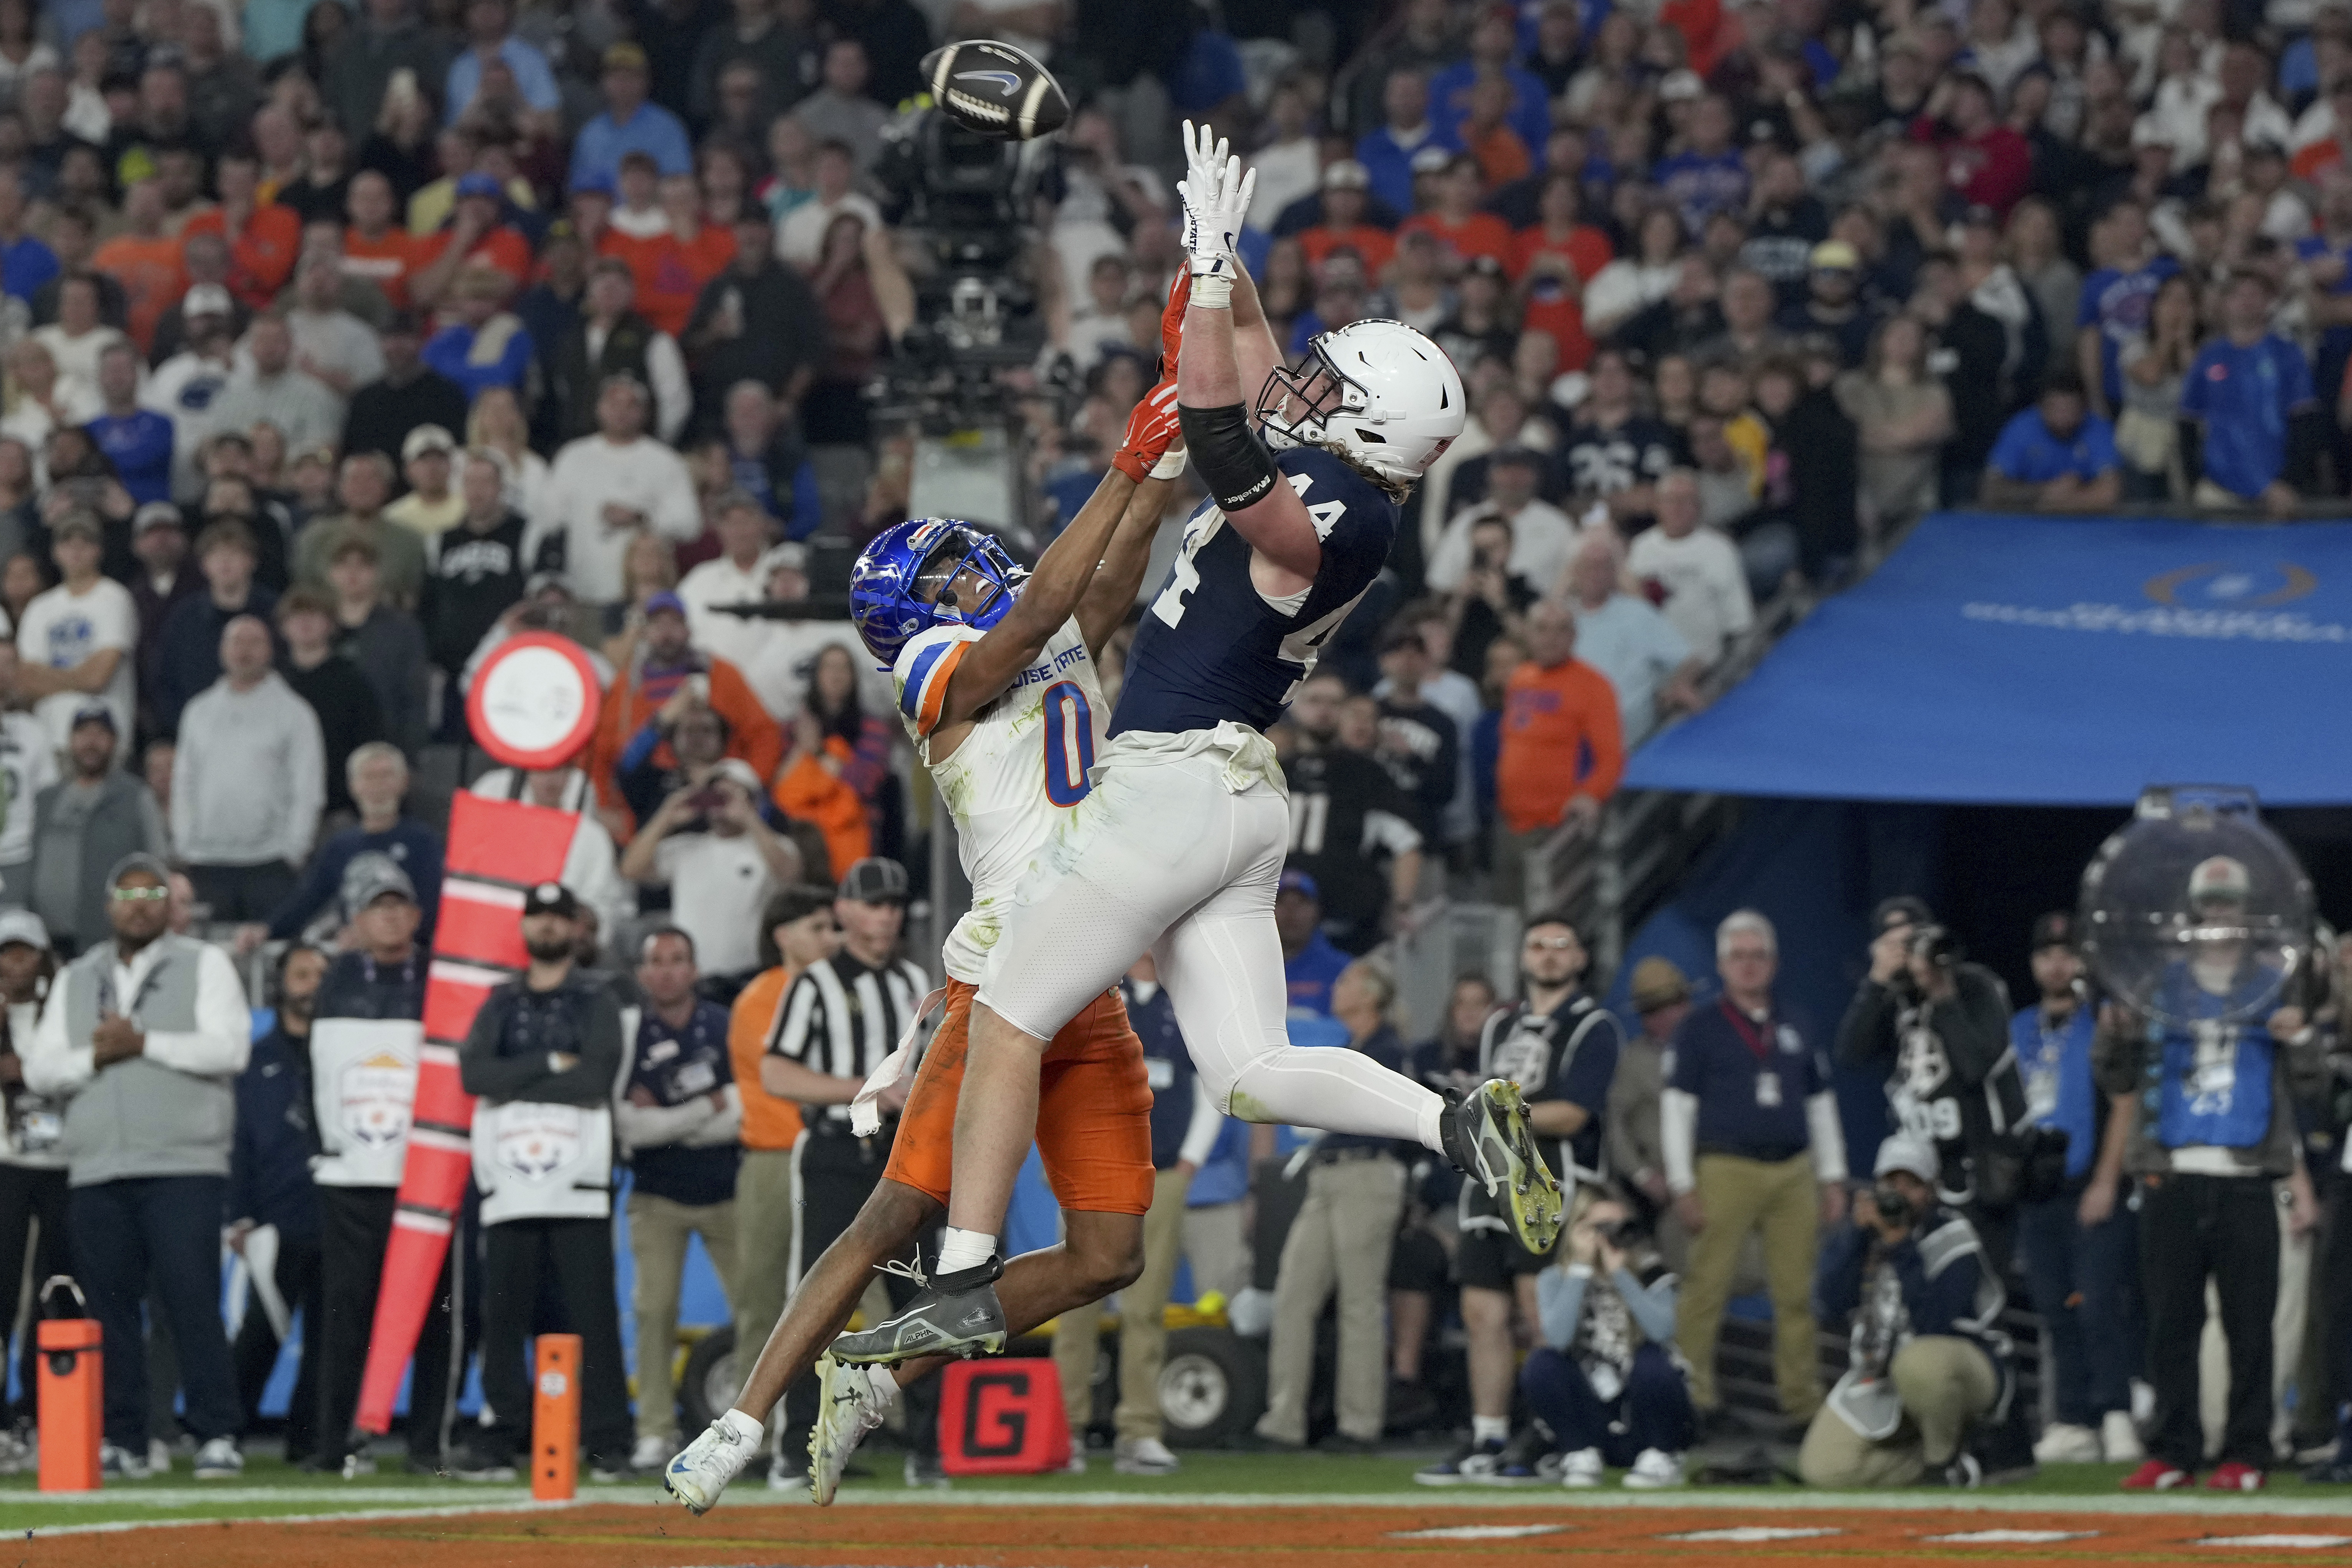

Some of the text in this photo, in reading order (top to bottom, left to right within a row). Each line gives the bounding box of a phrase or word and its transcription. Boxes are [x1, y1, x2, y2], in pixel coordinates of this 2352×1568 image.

[1011, 663, 1053, 689] OISE
[1042, 680, 1095, 807] 0
[905, 1329, 934, 1343] ALPHA
[963, 1374, 1029, 1458] G
